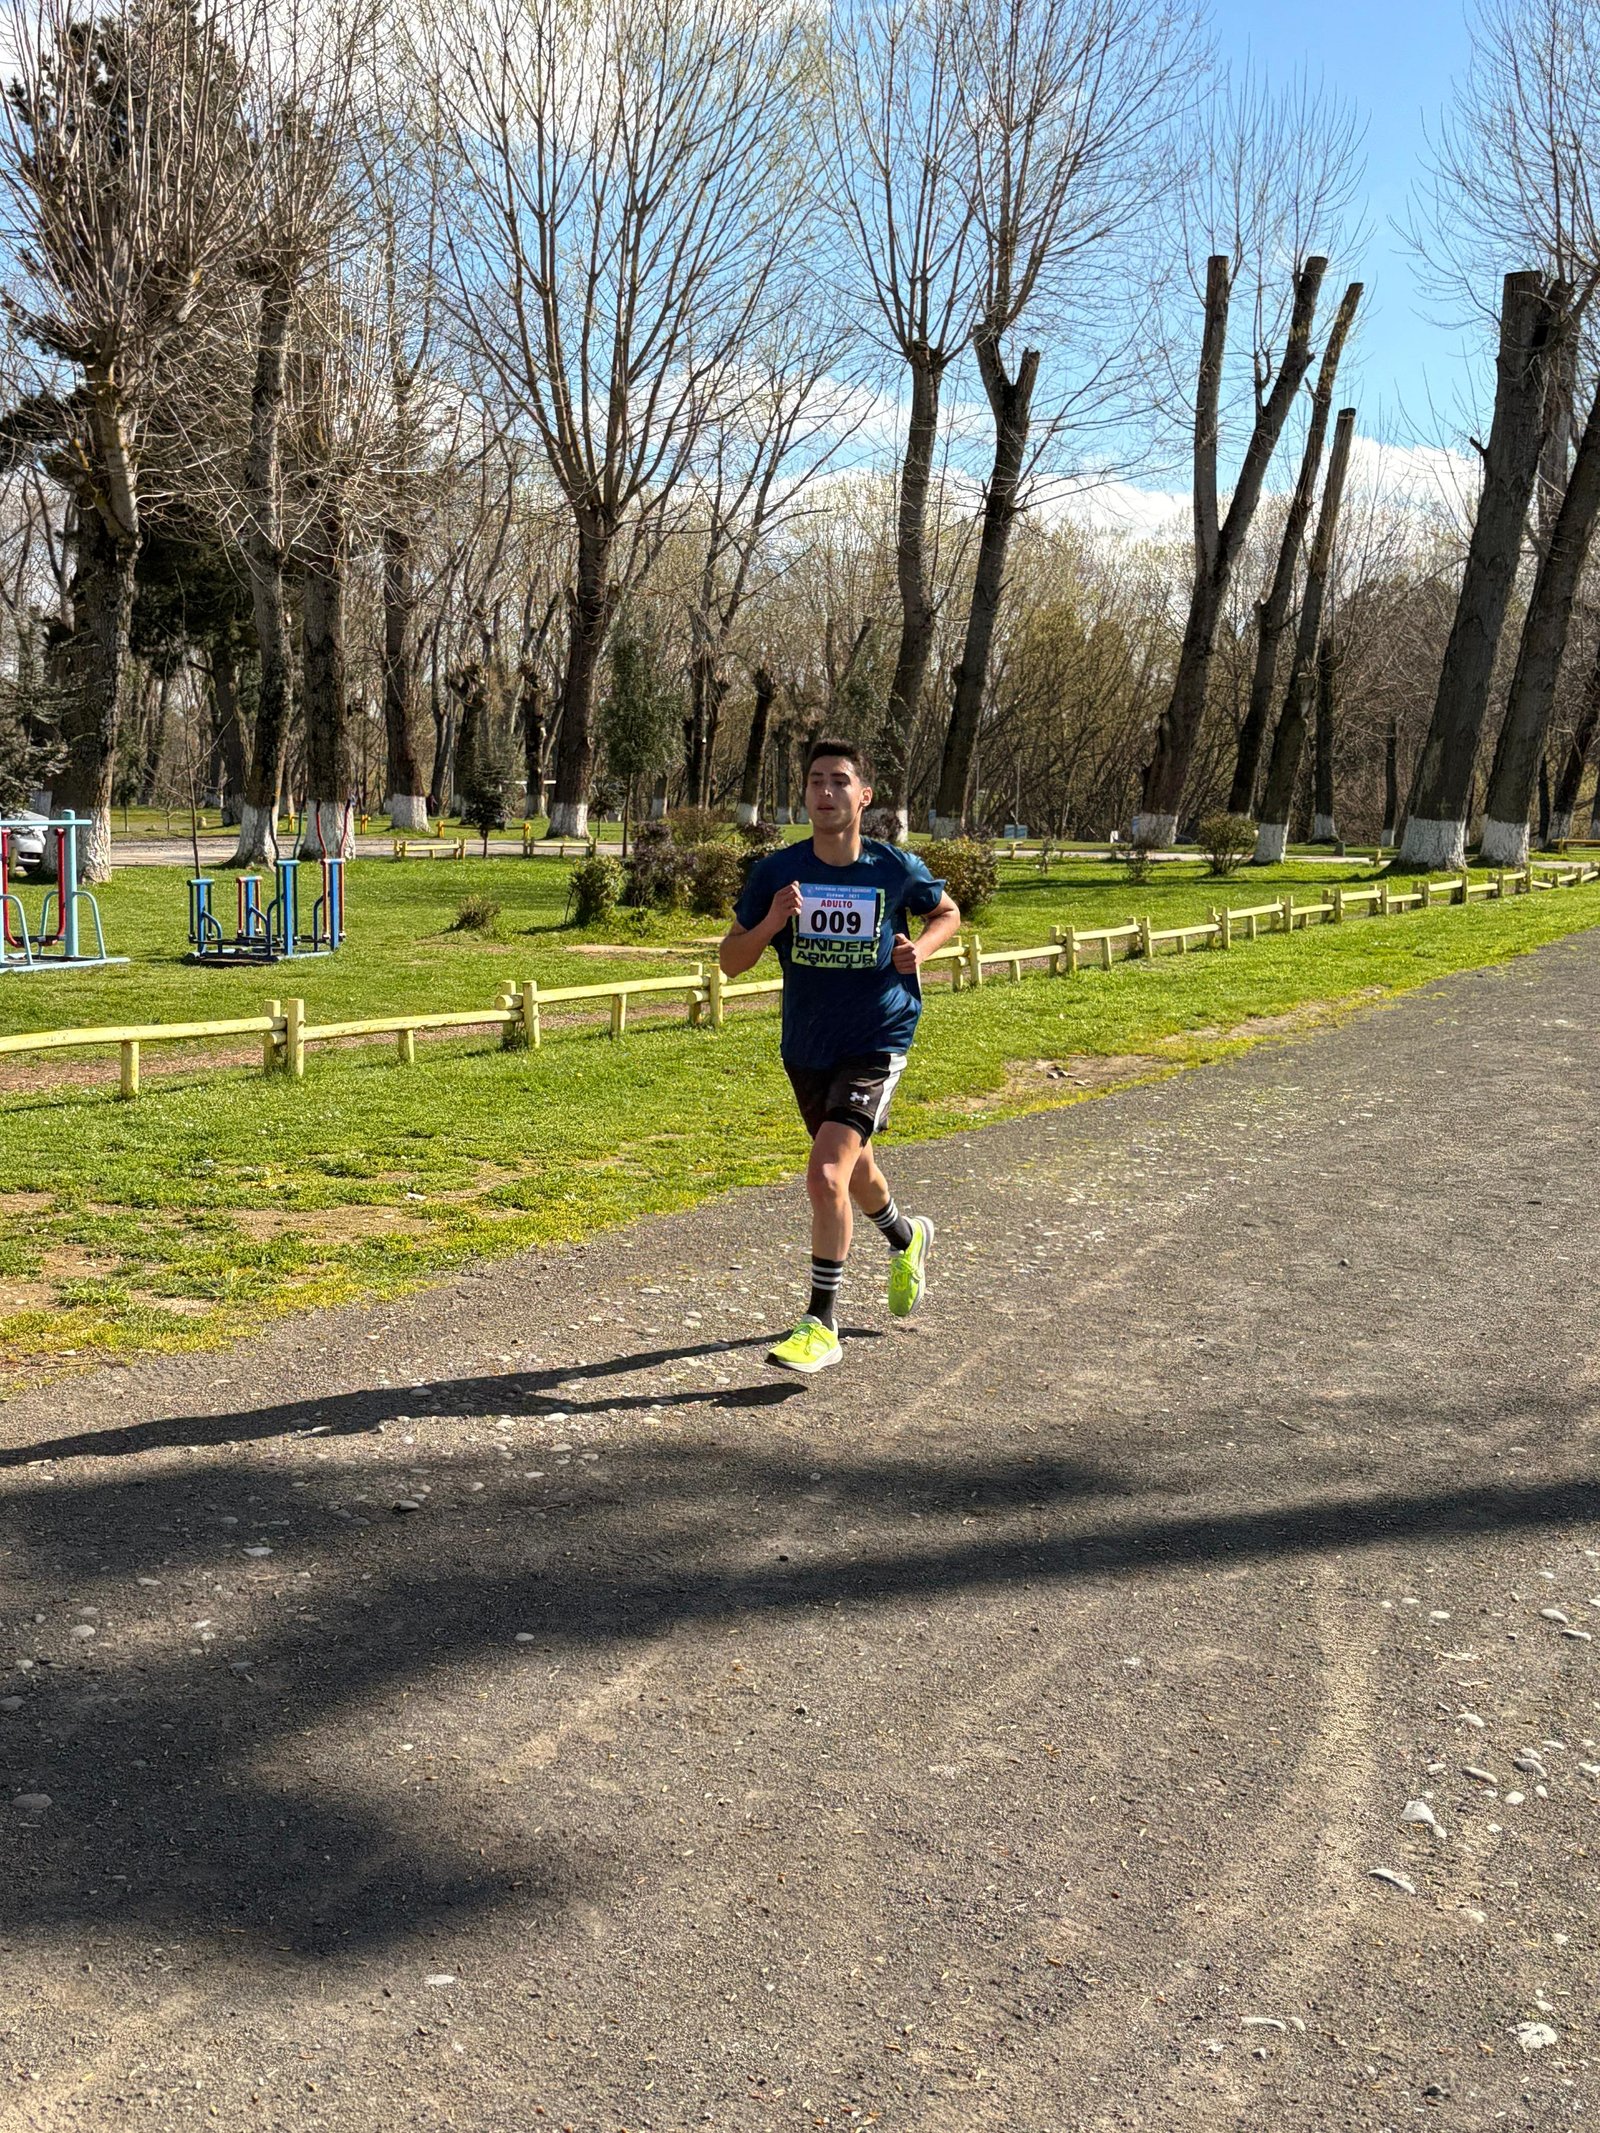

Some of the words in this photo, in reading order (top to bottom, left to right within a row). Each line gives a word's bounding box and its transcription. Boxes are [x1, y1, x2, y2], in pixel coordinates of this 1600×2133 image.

[820, 900, 853, 909] ADULTO
[811, 910, 861, 934] 009
[796, 938, 874, 952] UNDER
[796, 951, 874, 964] ARMOUR
